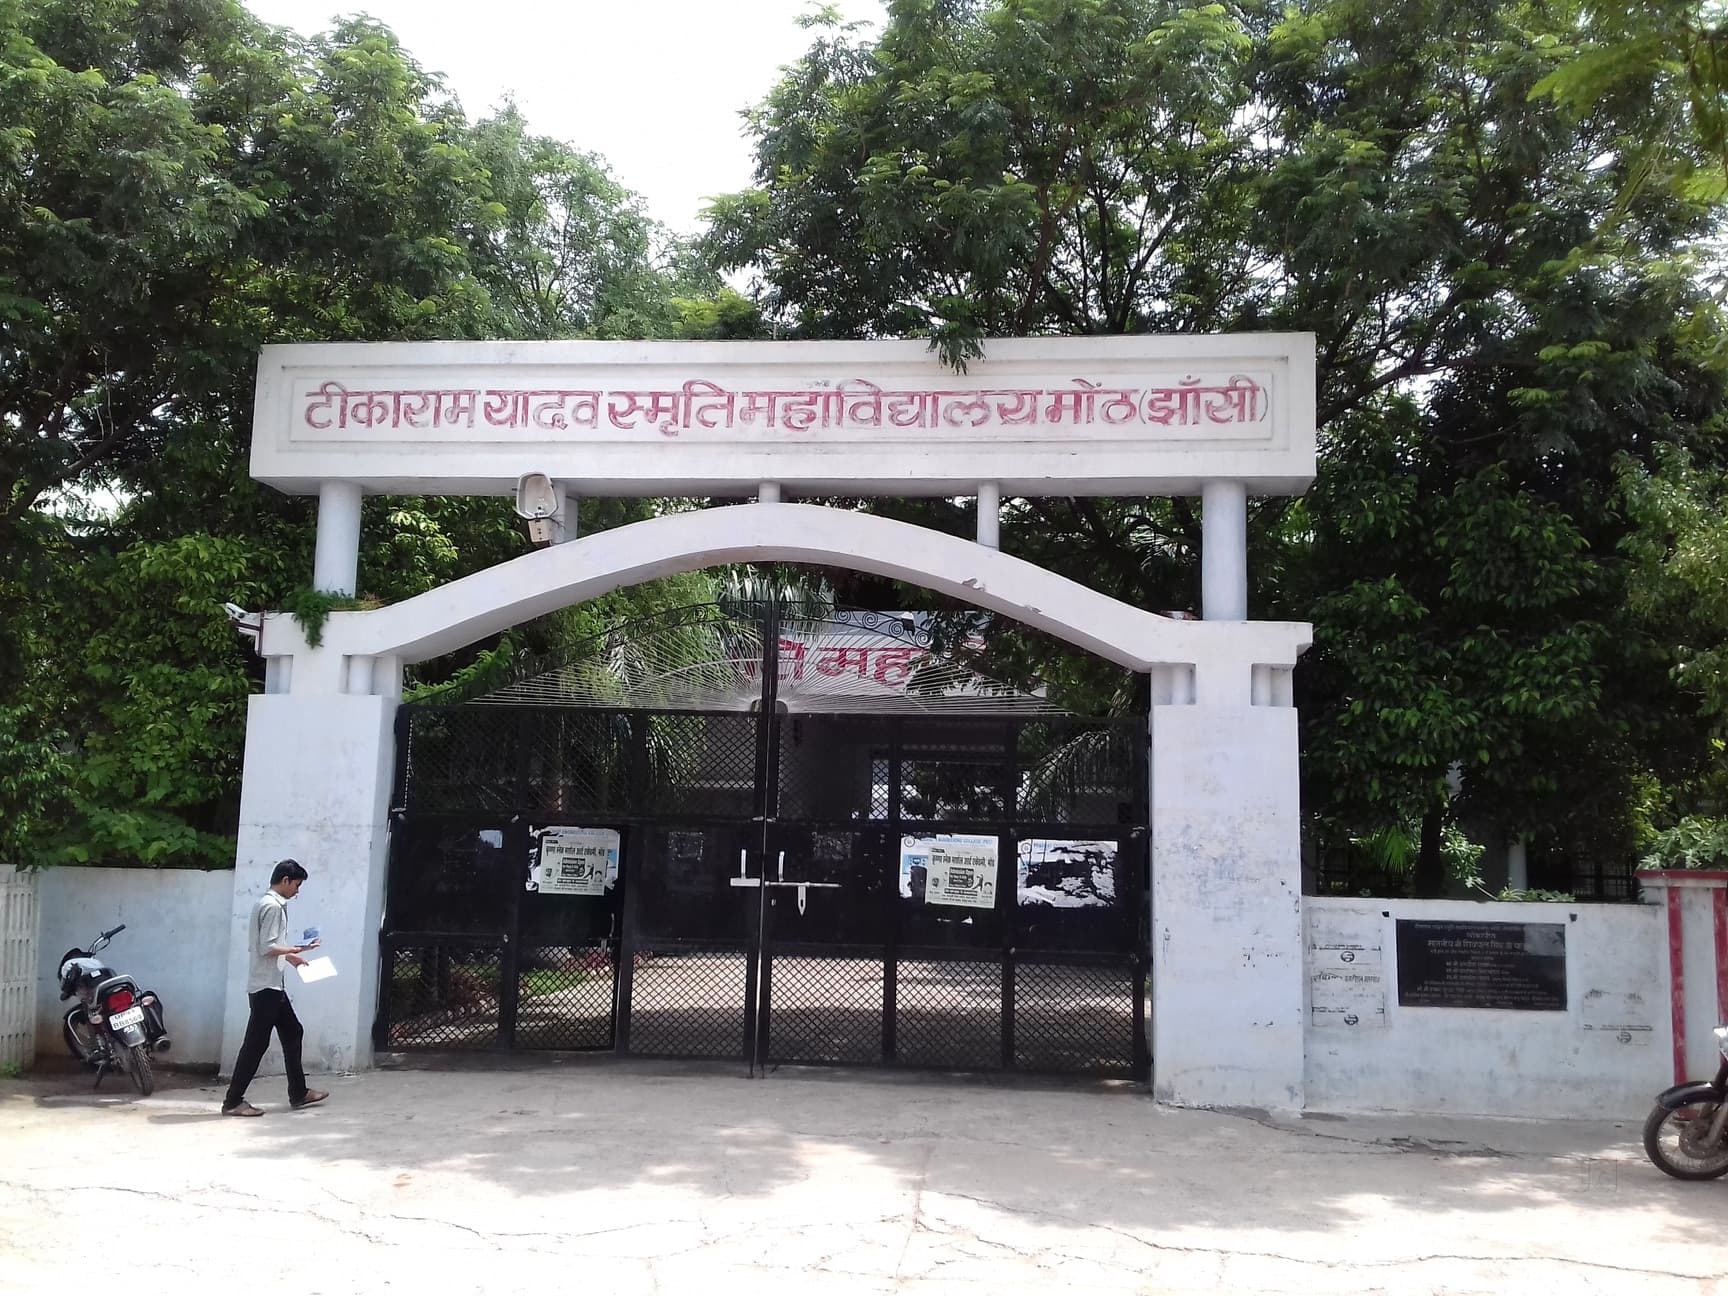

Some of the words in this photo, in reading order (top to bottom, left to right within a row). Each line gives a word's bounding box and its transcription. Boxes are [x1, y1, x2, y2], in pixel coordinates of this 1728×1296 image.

[305, 381, 480, 430] टीकाराम
[483, 388, 602, 431] यादव
[608, 378, 736, 437] स्मृति
[738, 378, 1043, 433] महाविद्यालय
[1045, 377, 1140, 425] मोंठ
